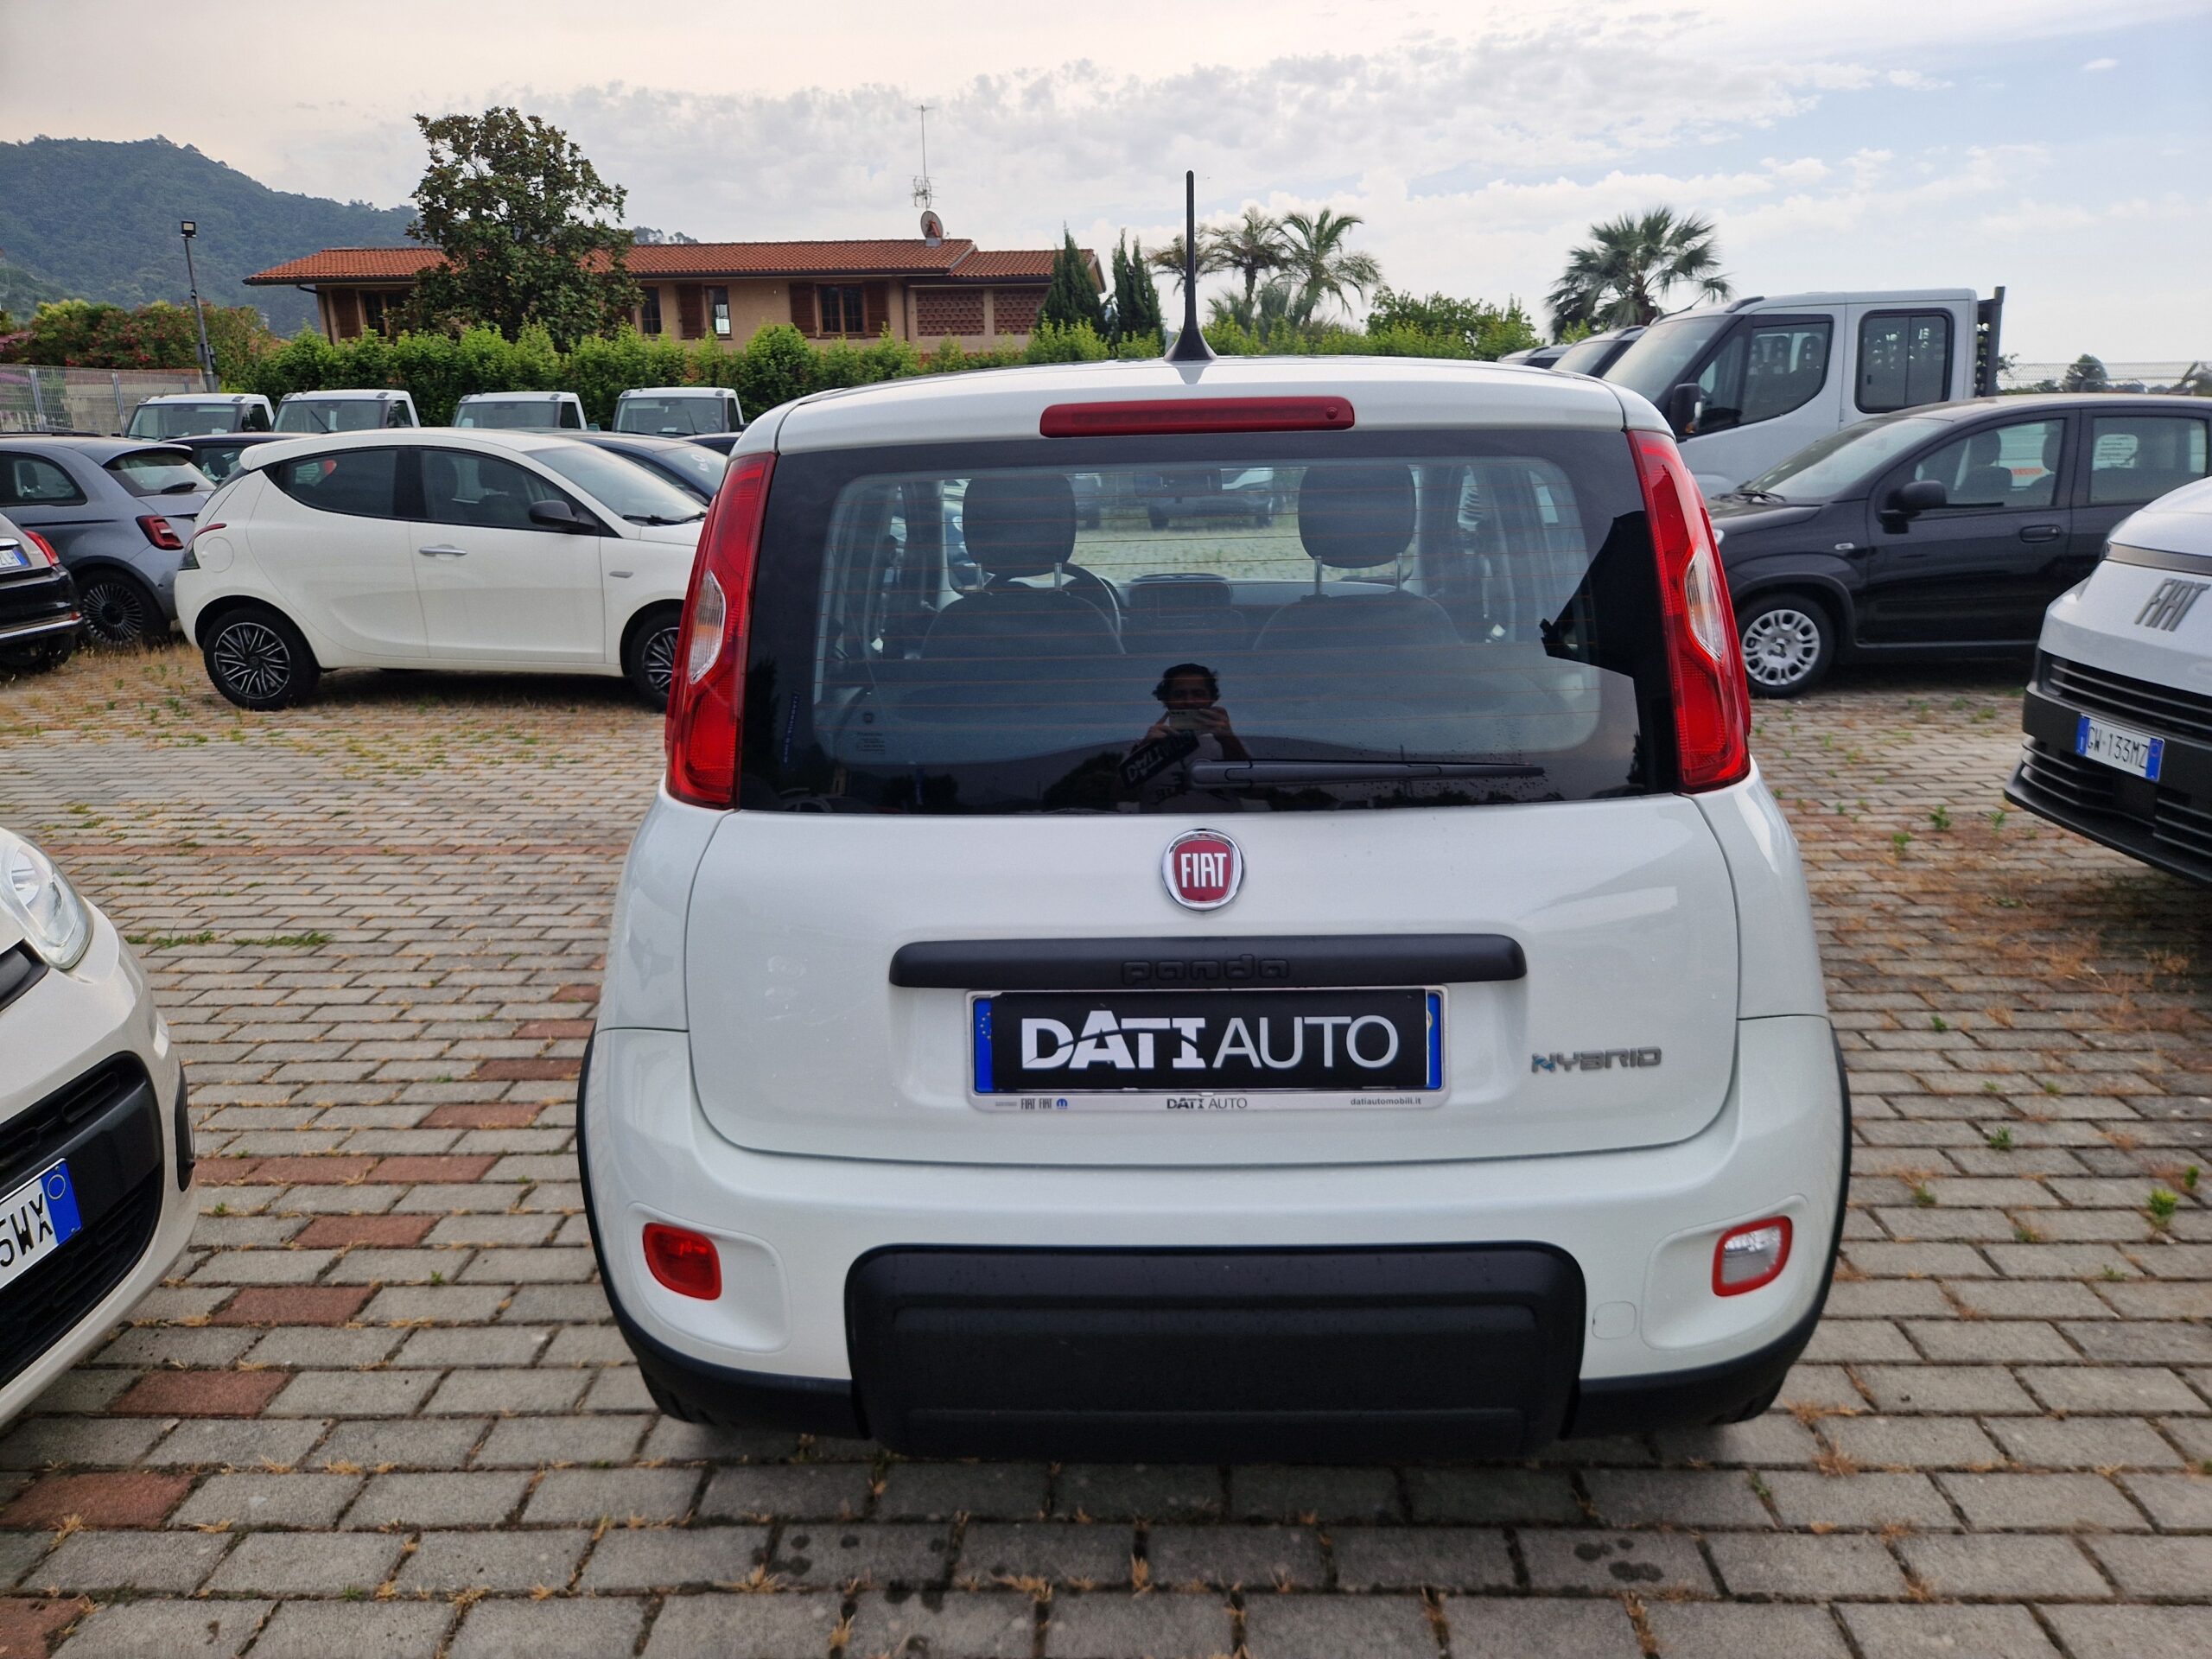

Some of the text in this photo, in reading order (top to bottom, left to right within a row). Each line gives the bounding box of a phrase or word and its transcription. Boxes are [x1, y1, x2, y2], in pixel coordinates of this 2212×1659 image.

[2133, 578, 2211, 632] FIAT
[1180, 852, 1228, 888] FIAT
[1122, 953, 1289, 986] panda
[1021, 1010, 1399, 1070] DATI AUTO
[1531, 1046, 1662, 1073] HYBRID
[1020, 1098, 1036, 1109] FIAT
[1166, 1096, 1248, 1109] DATI AUTO
[1350, 1096, 1422, 1106] datiautomobili.it
